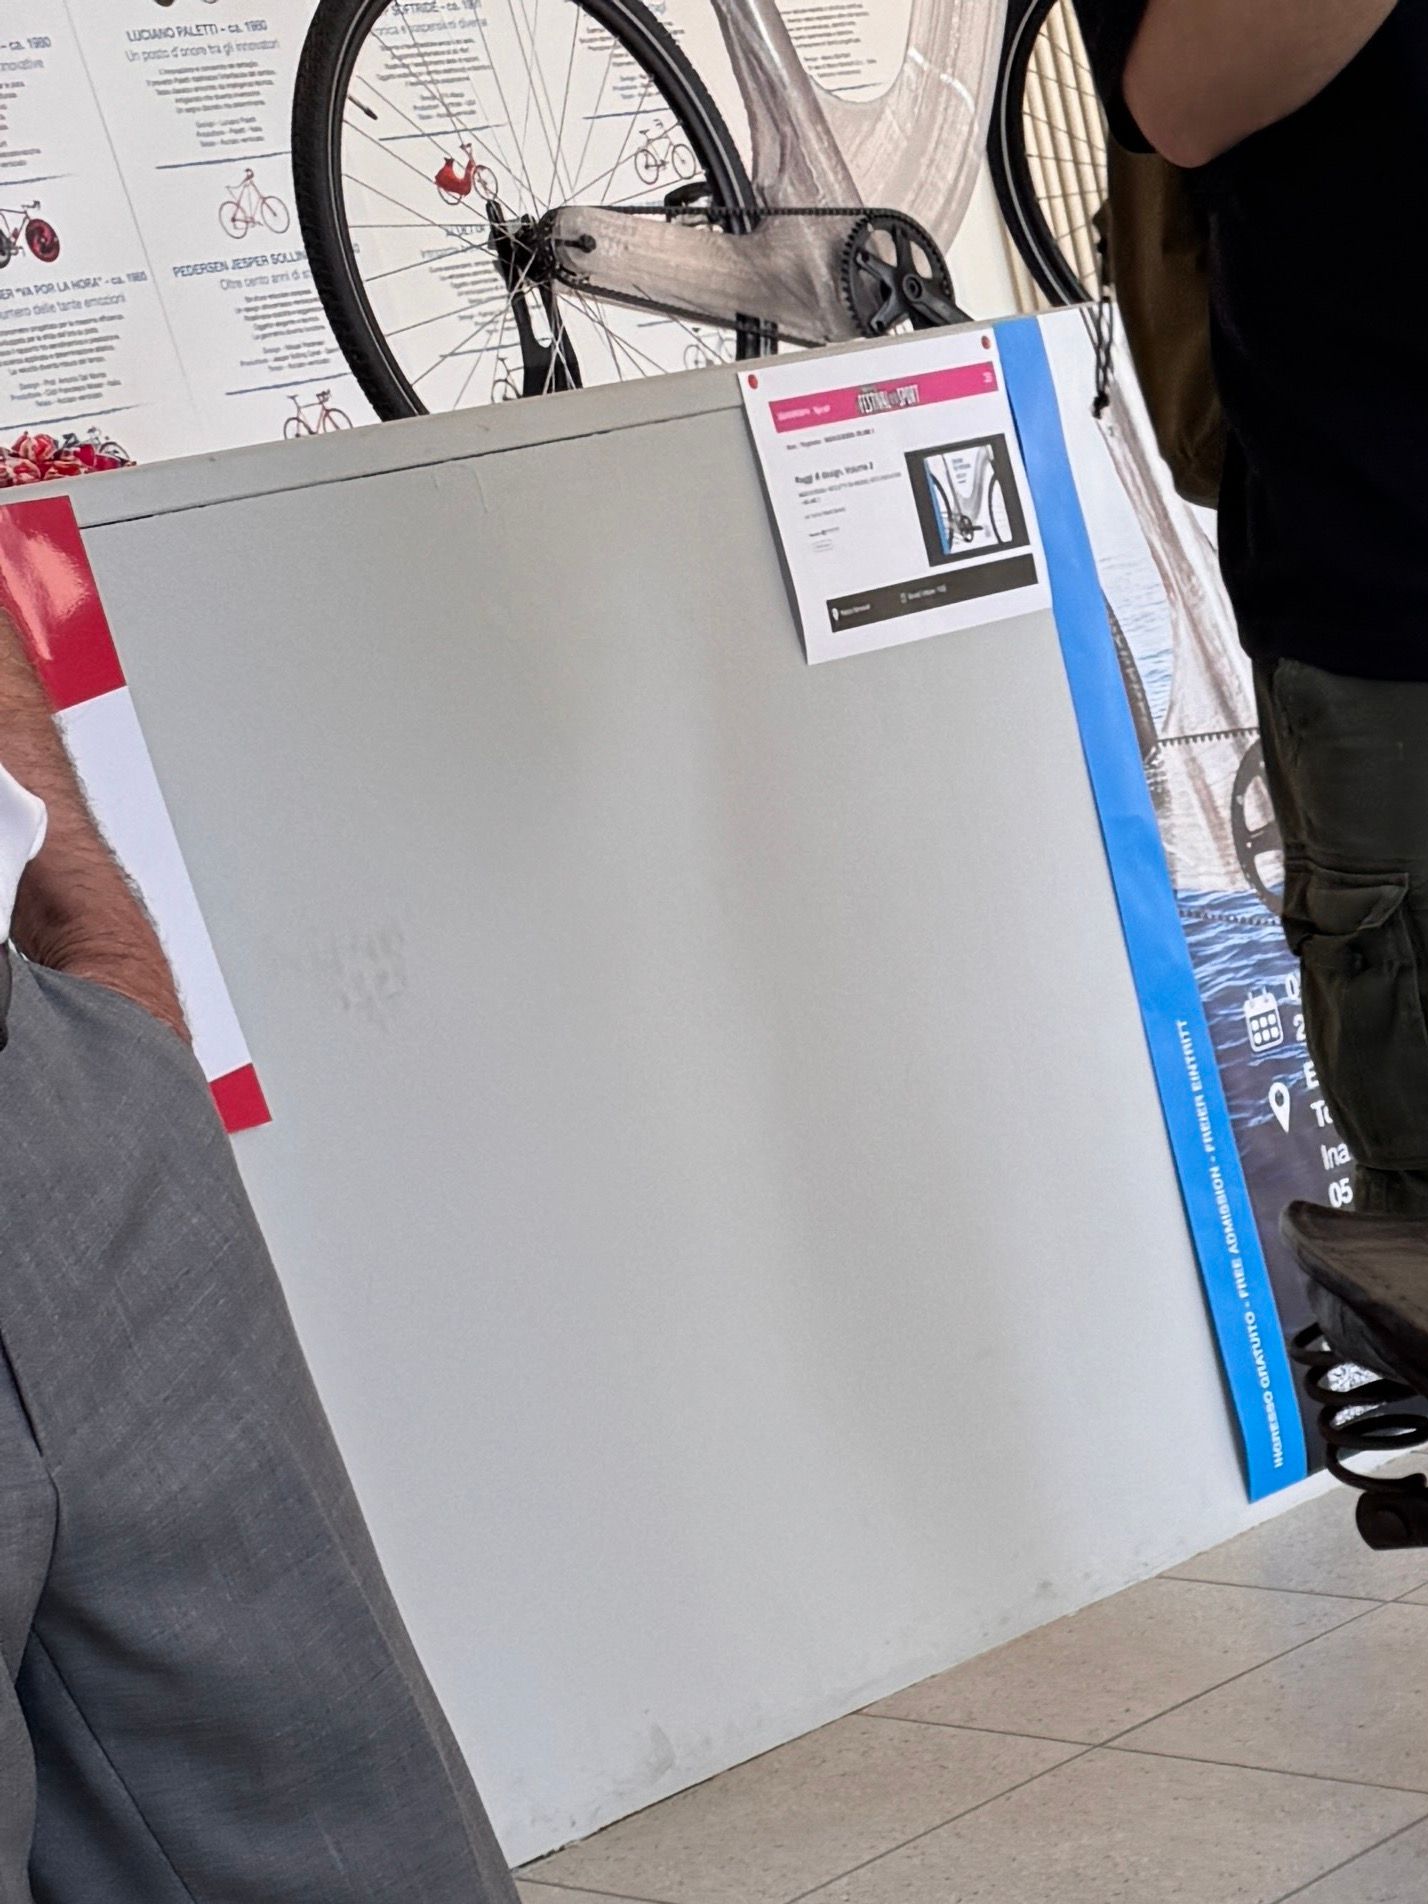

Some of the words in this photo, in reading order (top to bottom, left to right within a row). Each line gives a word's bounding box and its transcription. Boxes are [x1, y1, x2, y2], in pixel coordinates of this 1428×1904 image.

[126, 26, 176, 42] LUCIANO
[177, 23, 219, 38] PALETTI
[173, 260, 229, 278] PEDERSEN
[230, 255, 270, 271] JESPER
[271, 250, 310, 265] SOLLIN
[1177, 1019, 1202, 1091] EINTRITT
[1194, 1094, 1215, 1152] FREIER
[1320, 1142, 1351, 1171] Ina
[1208, 1166, 1239, 1254] ADMISSION
[1232, 1258, 1249, 1299] FREE
[1245, 1311, 1271, 1389] GRATUITO
[1263, 1390, 1284, 1469] INGRESSO
